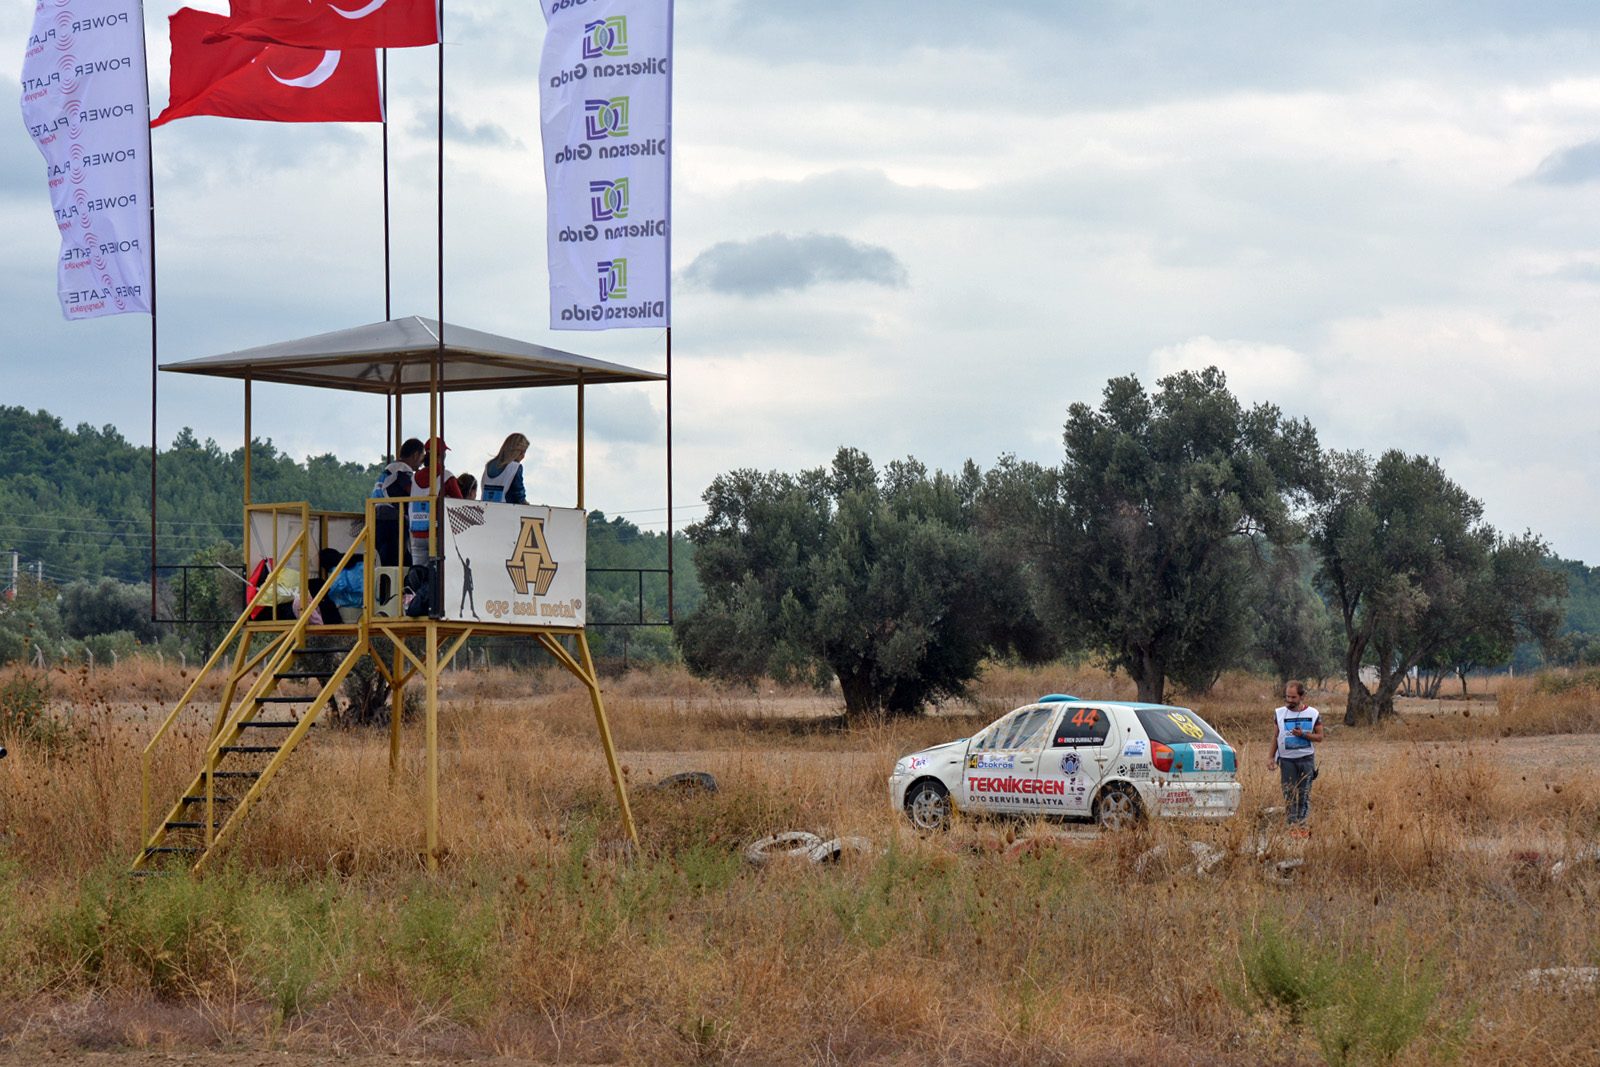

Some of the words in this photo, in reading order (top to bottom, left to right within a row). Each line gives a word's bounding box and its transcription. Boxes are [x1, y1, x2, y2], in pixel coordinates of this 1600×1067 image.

[485, 599, 509, 618] ege
[513, 596, 538, 616] asal
[1071, 708, 1098, 727] 44
[977, 761, 1014, 769] Otokros
[968, 775, 1065, 796] TEKNİKEREN
[969, 795, 987, 803] OTO
[988, 795, 1020, 804] SERVİS
[1022, 797, 1064, 806] MALATYA
